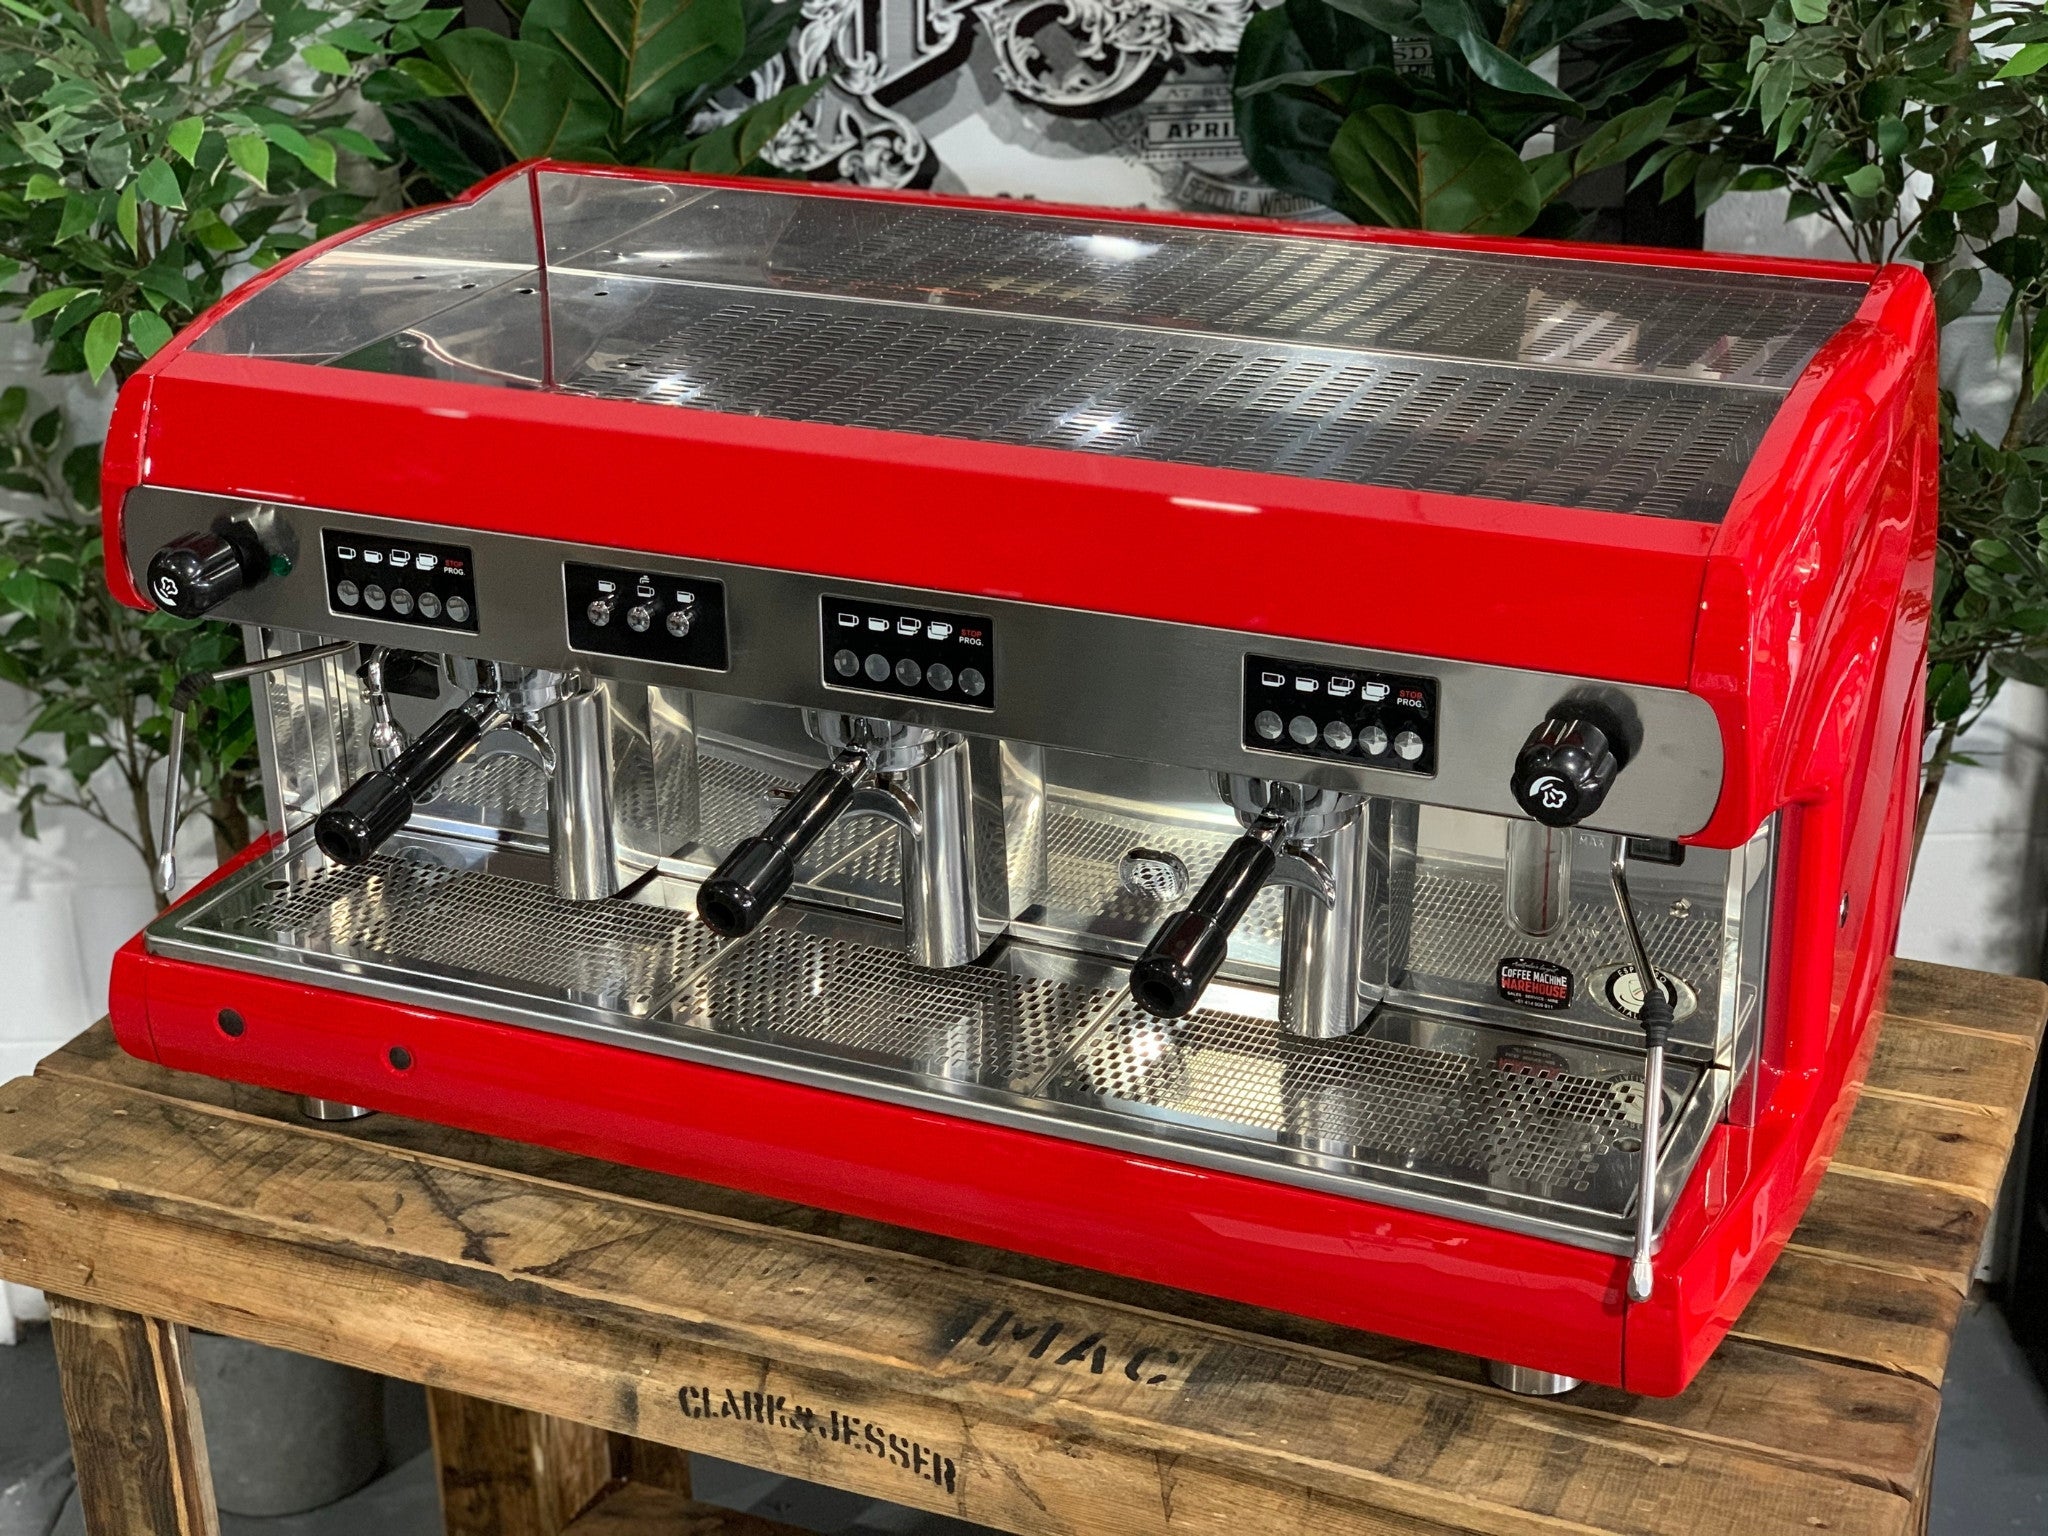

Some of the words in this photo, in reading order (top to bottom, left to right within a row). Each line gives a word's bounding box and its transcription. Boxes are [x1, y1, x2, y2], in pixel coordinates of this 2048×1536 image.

[1168, 122, 1230, 138] APRI
[445, 559, 463, 567] STOP
[443, 566, 466, 576] PROG.
[961, 629, 982, 637] STOP
[959, 636, 984, 647] PROG.
[1400, 690, 1422, 699] STOP
[1396, 697, 1424, 708] PROG.
[1580, 836, 1604, 848] MAX
[1502, 966, 1532, 980] COFFEE
[1533, 971, 1567, 987] MACHINE
[1617, 966, 1667, 983] ESPSO
[1502, 977, 1567, 999] WAREHOUSE
[1618, 1006, 1638, 1019] ITAL
